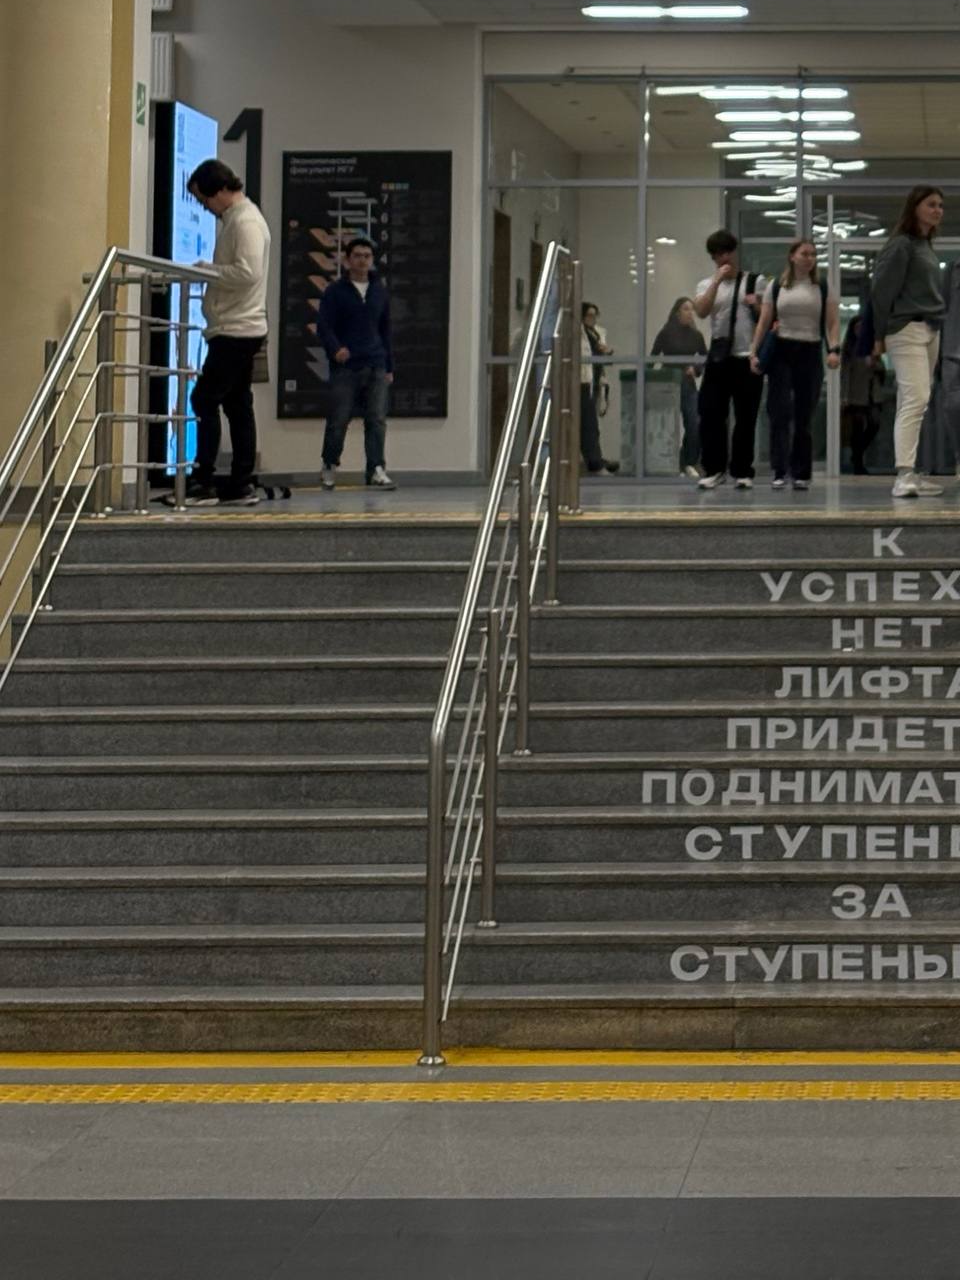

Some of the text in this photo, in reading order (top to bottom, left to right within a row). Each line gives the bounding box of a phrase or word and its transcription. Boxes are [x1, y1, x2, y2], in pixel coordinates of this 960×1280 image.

[223, 108, 264, 209] 1
[872, 527, 904, 557] К
[832, 618, 943, 650] НЕТ
[831, 883, 912, 920] ЗА
